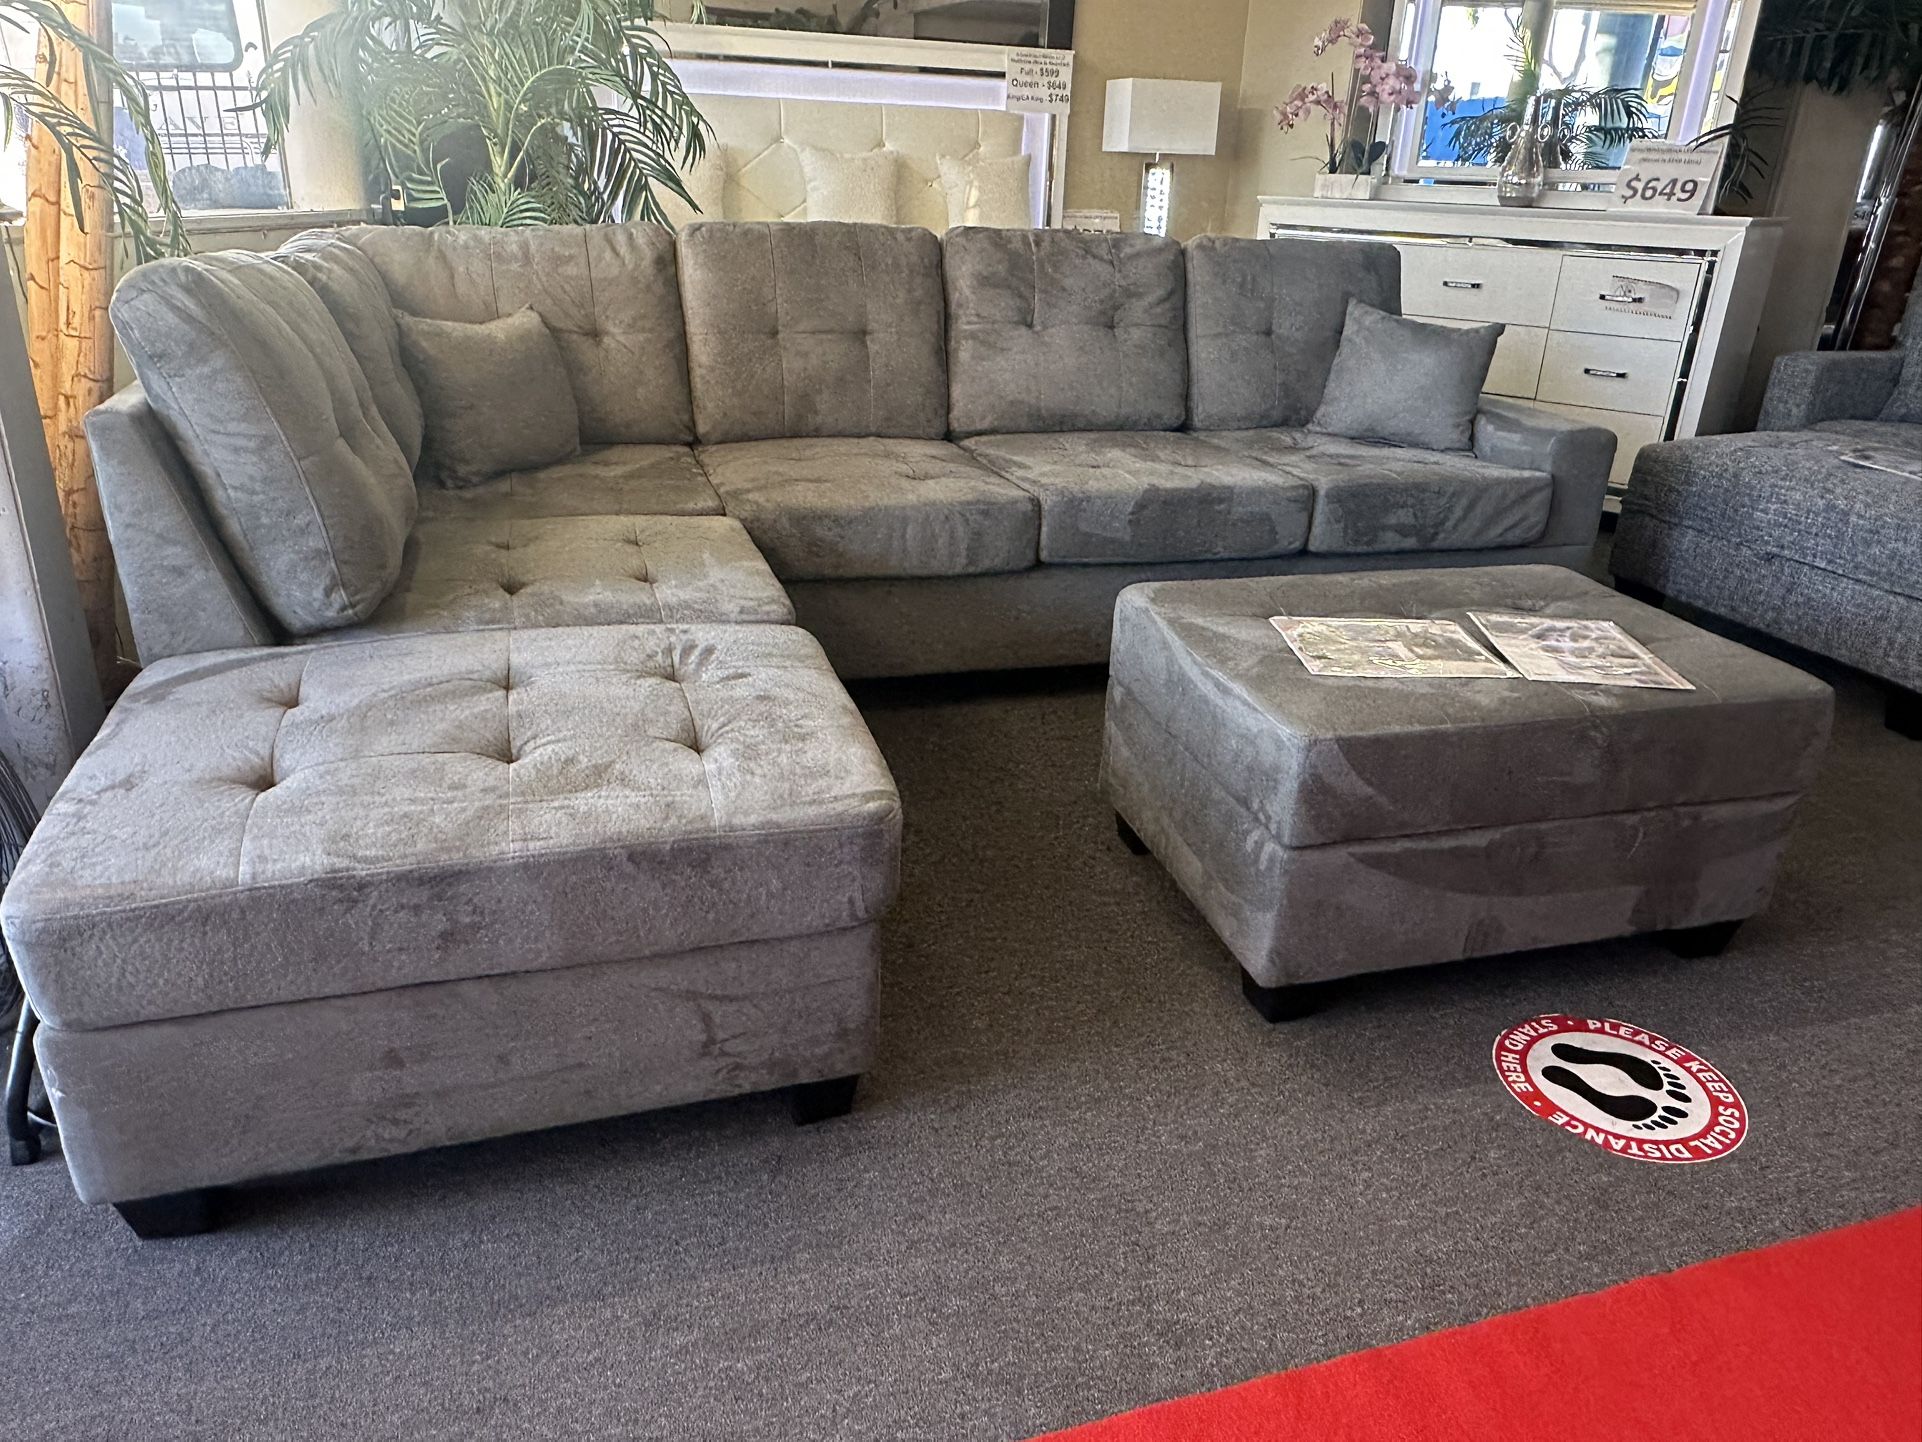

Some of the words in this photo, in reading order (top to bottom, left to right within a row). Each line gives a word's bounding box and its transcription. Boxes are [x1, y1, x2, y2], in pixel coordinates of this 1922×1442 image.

[1011, 78, 1040, 88] Queen
[1621, 172, 1699, 204] $649
[1504, 1019, 1559, 1051] STAND
[1587, 1019, 1686, 1060] PLEASE
[1500, 1051, 1534, 1093] HERE
[1683, 1060, 1735, 1103] KEEP
[1548, 1110, 1693, 1159] DISTANCE
[1688, 1105, 1741, 1154] SOCIAL
